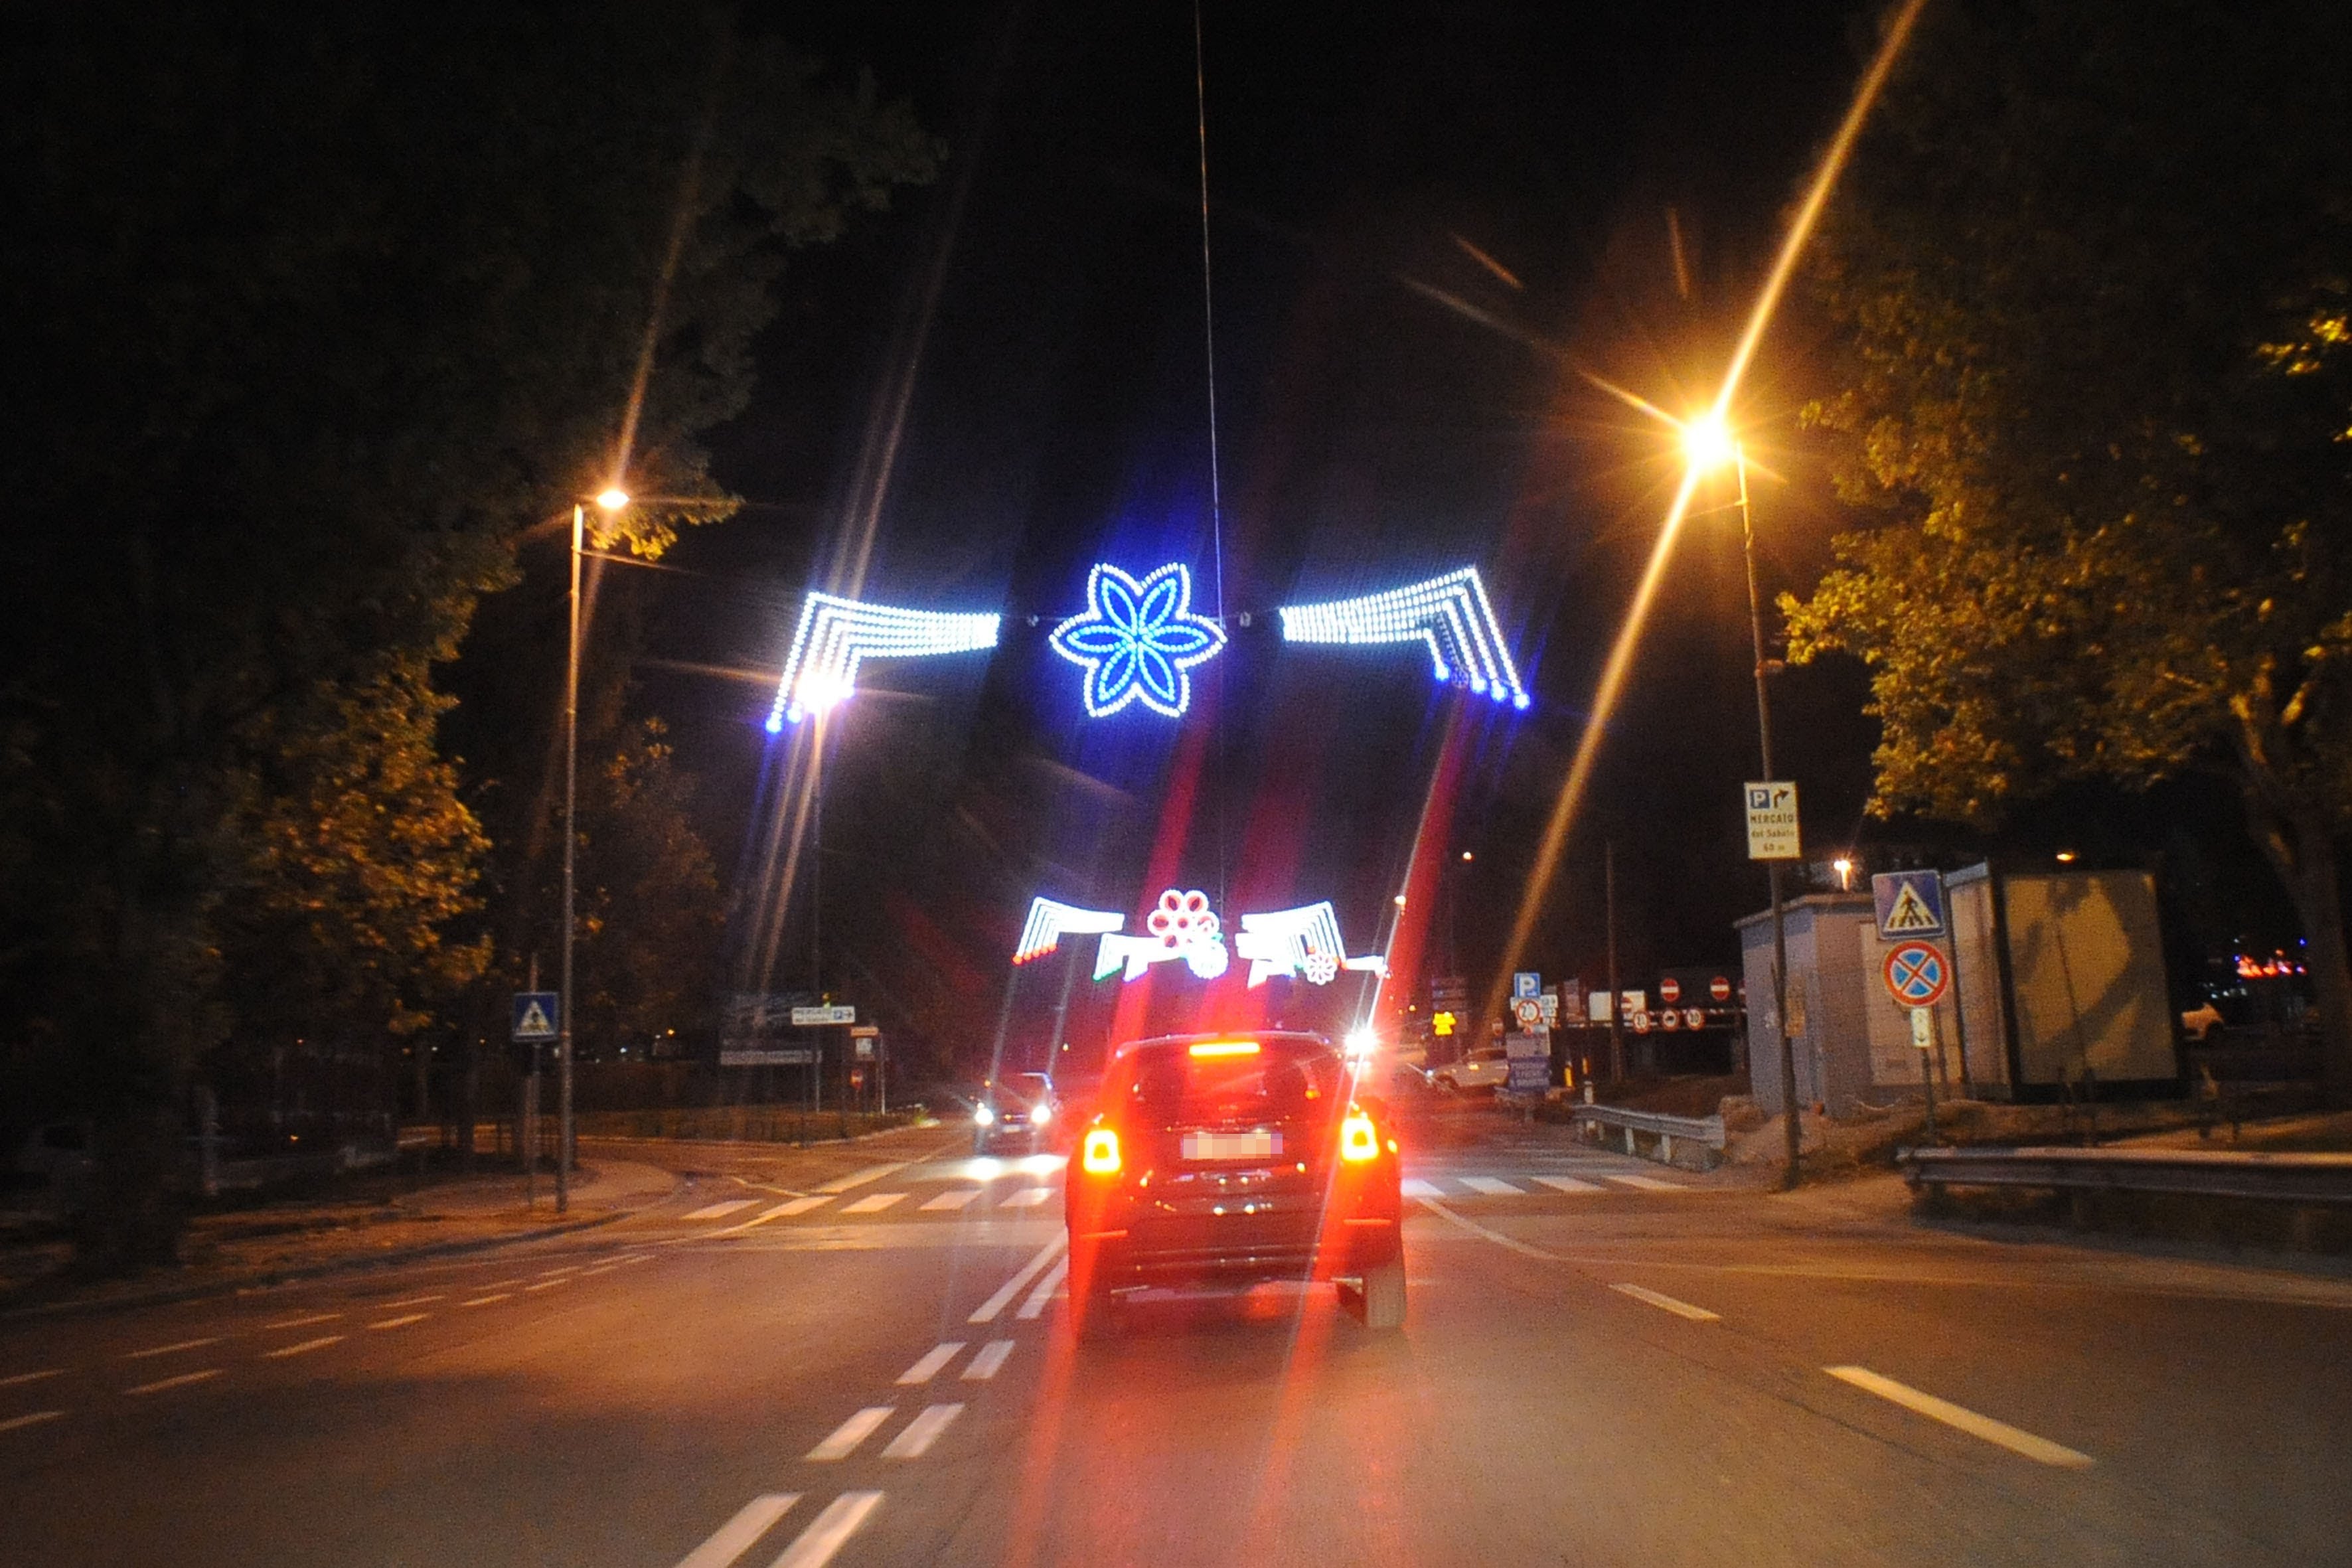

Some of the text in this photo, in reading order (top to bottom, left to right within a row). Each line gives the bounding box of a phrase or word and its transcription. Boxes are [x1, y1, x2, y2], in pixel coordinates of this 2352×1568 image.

[1753, 791, 1766, 807] P
[1751, 813, 1794, 824] MERCATO
[1520, 976, 1535, 996] P
